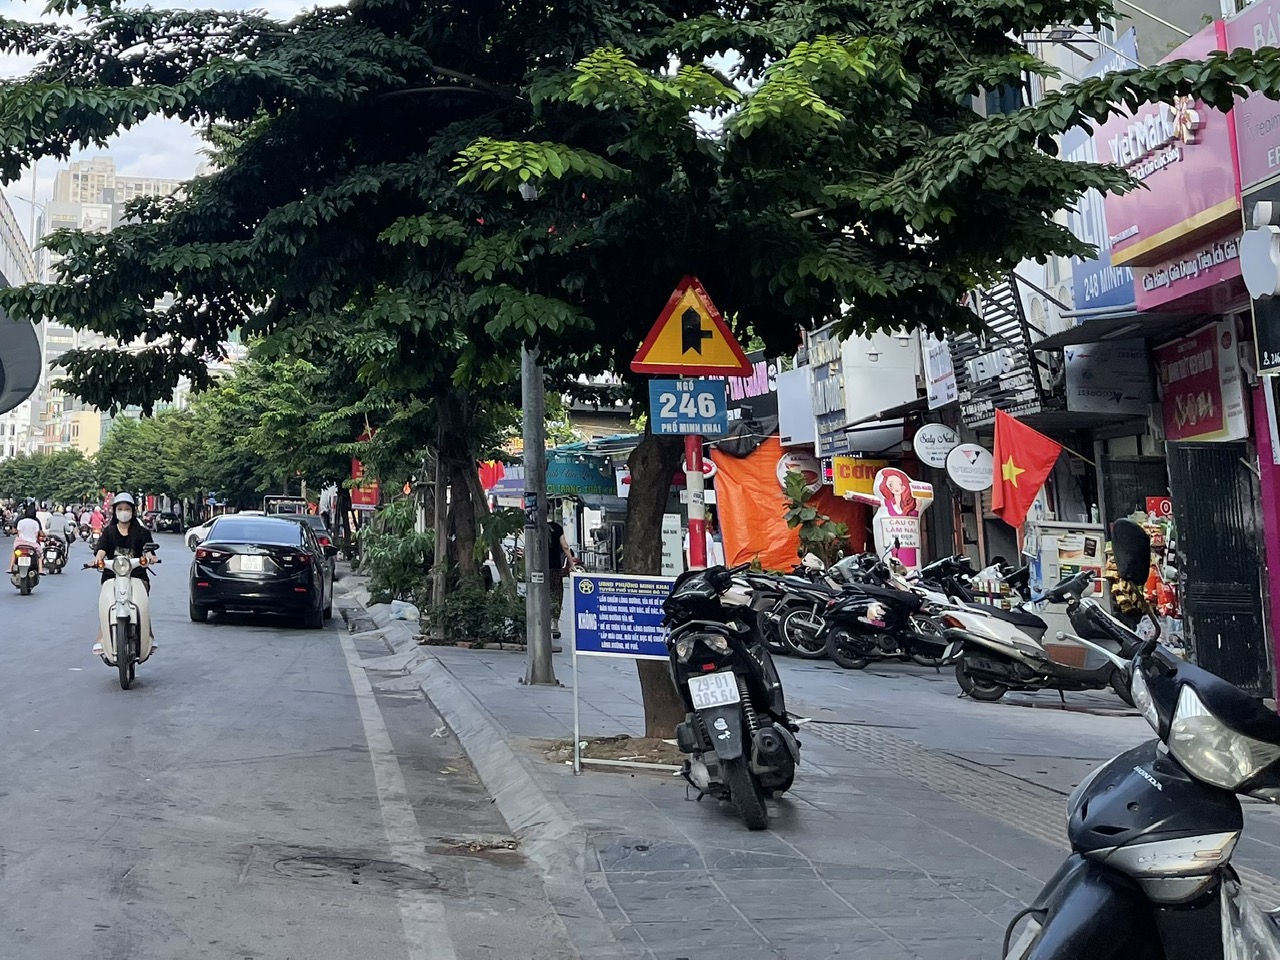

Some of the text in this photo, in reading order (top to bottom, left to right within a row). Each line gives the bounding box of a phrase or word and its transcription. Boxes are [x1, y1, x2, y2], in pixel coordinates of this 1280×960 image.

[1153, 269, 1169, 288] Hàng
[1169, 264, 1181, 281] Gia
[1180, 259, 1198, 280] Dụng
[1196, 250, 1213, 273] Tiện
[1084, 273, 1099, 301] 248
[1100, 265, 1124, 294] MINH
[660, 392, 716, 418] 246
[661, 420, 721, 433] PHỐ MINH KHAI
[577, 609, 597, 630] KHÔNG
[695, 688, 736, 705] 385.64
[1133, 765, 1163, 791] HONDA
